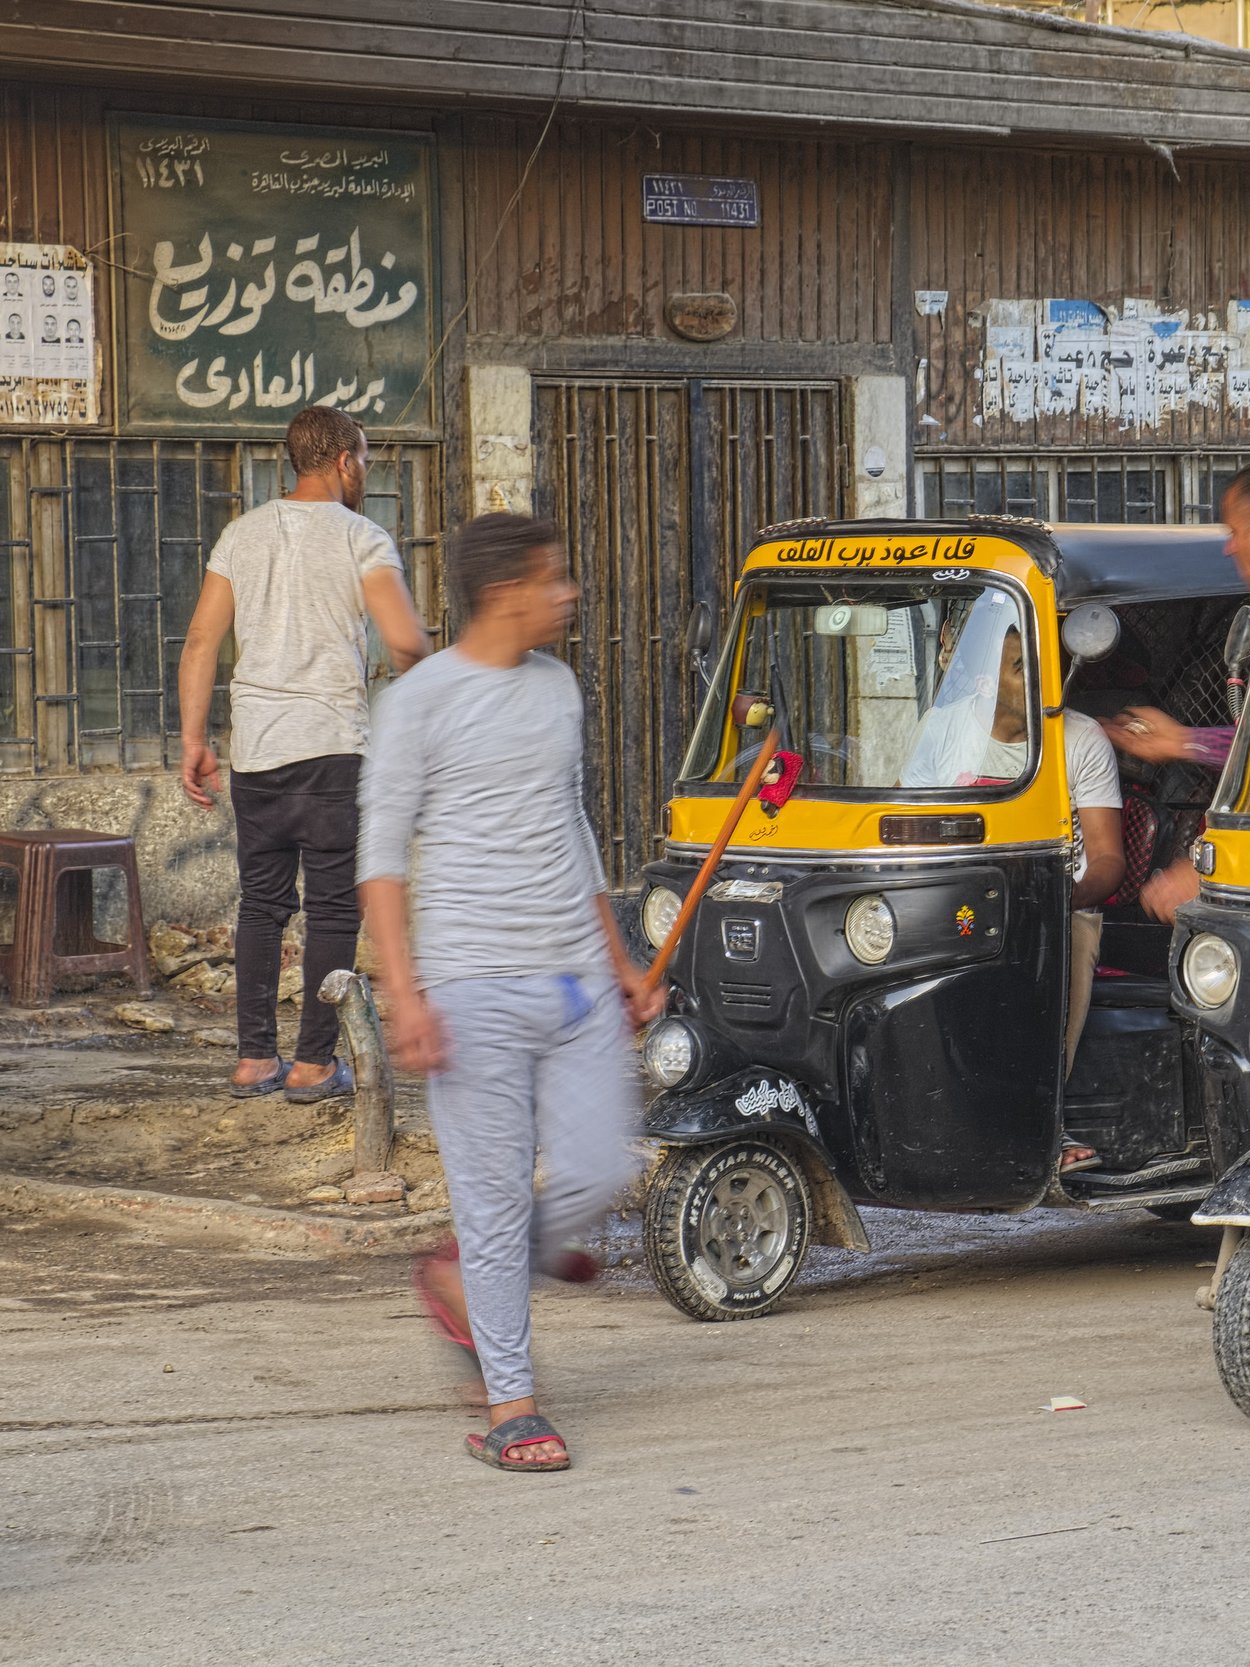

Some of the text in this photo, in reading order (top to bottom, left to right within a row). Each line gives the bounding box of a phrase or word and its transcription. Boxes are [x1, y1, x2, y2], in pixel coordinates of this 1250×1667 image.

[136, 157, 204, 188] ١١٤٣١
[252, 171, 289, 193] القاهرة
[647, 200, 750, 218] POST NO 11431
[149, 226, 417, 341] منطقة توزيع
[313, 376, 385, 414] بريد
[837, 547, 876, 567] برب
[943, 537, 976, 560] قل
[709, 1151, 748, 1181] STAR
[752, 1152, 796, 1190] MILER
